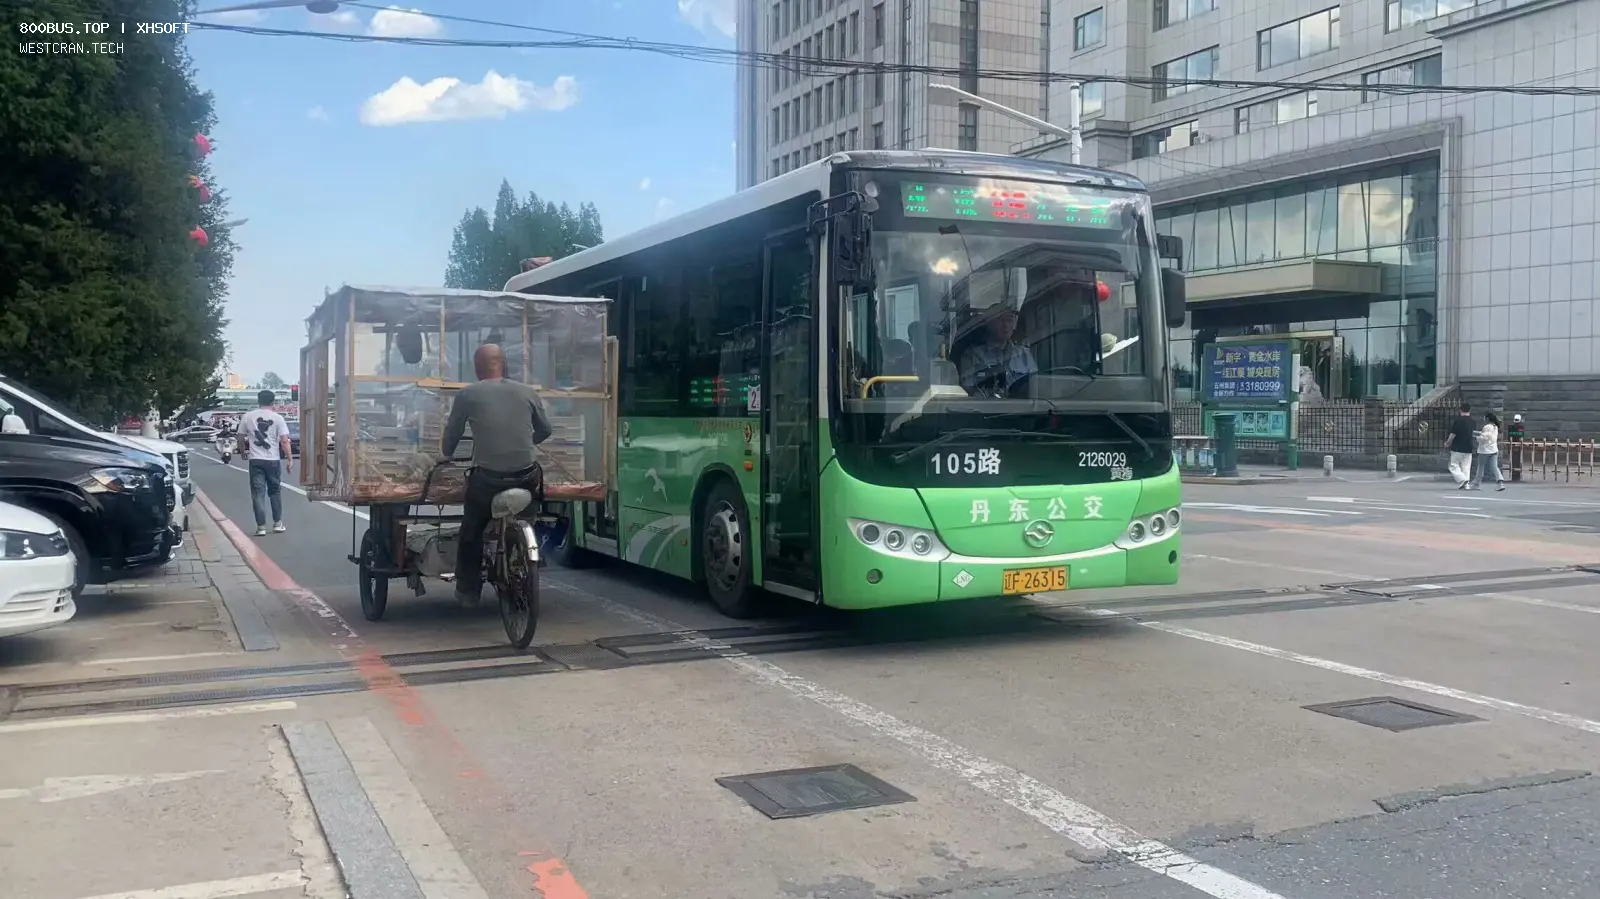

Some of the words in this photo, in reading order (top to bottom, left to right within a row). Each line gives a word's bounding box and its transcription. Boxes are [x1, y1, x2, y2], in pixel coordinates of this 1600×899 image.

[1245, 381, 1280, 391] 3180999
[930, 447, 1002, 475] 105路
[1078, 451, 1127, 467] 2126029
[1110, 466, 1133, 480] 黄海
[969, 496, 1104, 523] 丹东公交
